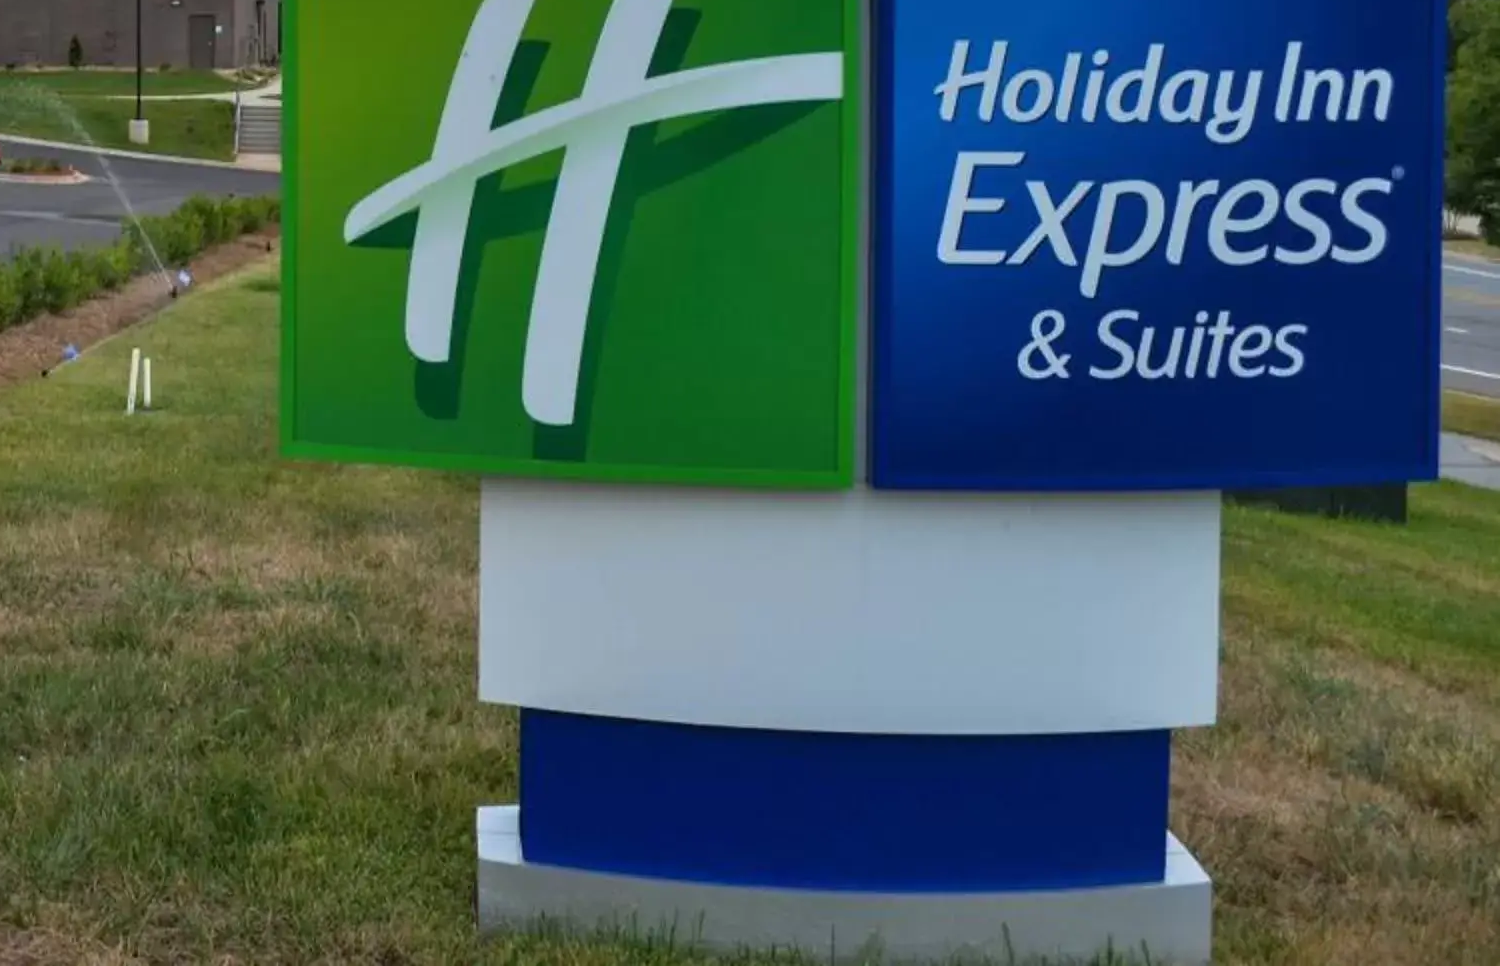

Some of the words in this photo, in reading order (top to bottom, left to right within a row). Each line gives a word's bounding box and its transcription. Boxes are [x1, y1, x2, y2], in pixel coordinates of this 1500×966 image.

[934, 40, 1263, 144] Holiday
[1275, 41, 1394, 123] Inn
[937, 150, 1393, 298] Express
[1017, 309, 1071, 379] &
[1088, 309, 1308, 379] Suites
